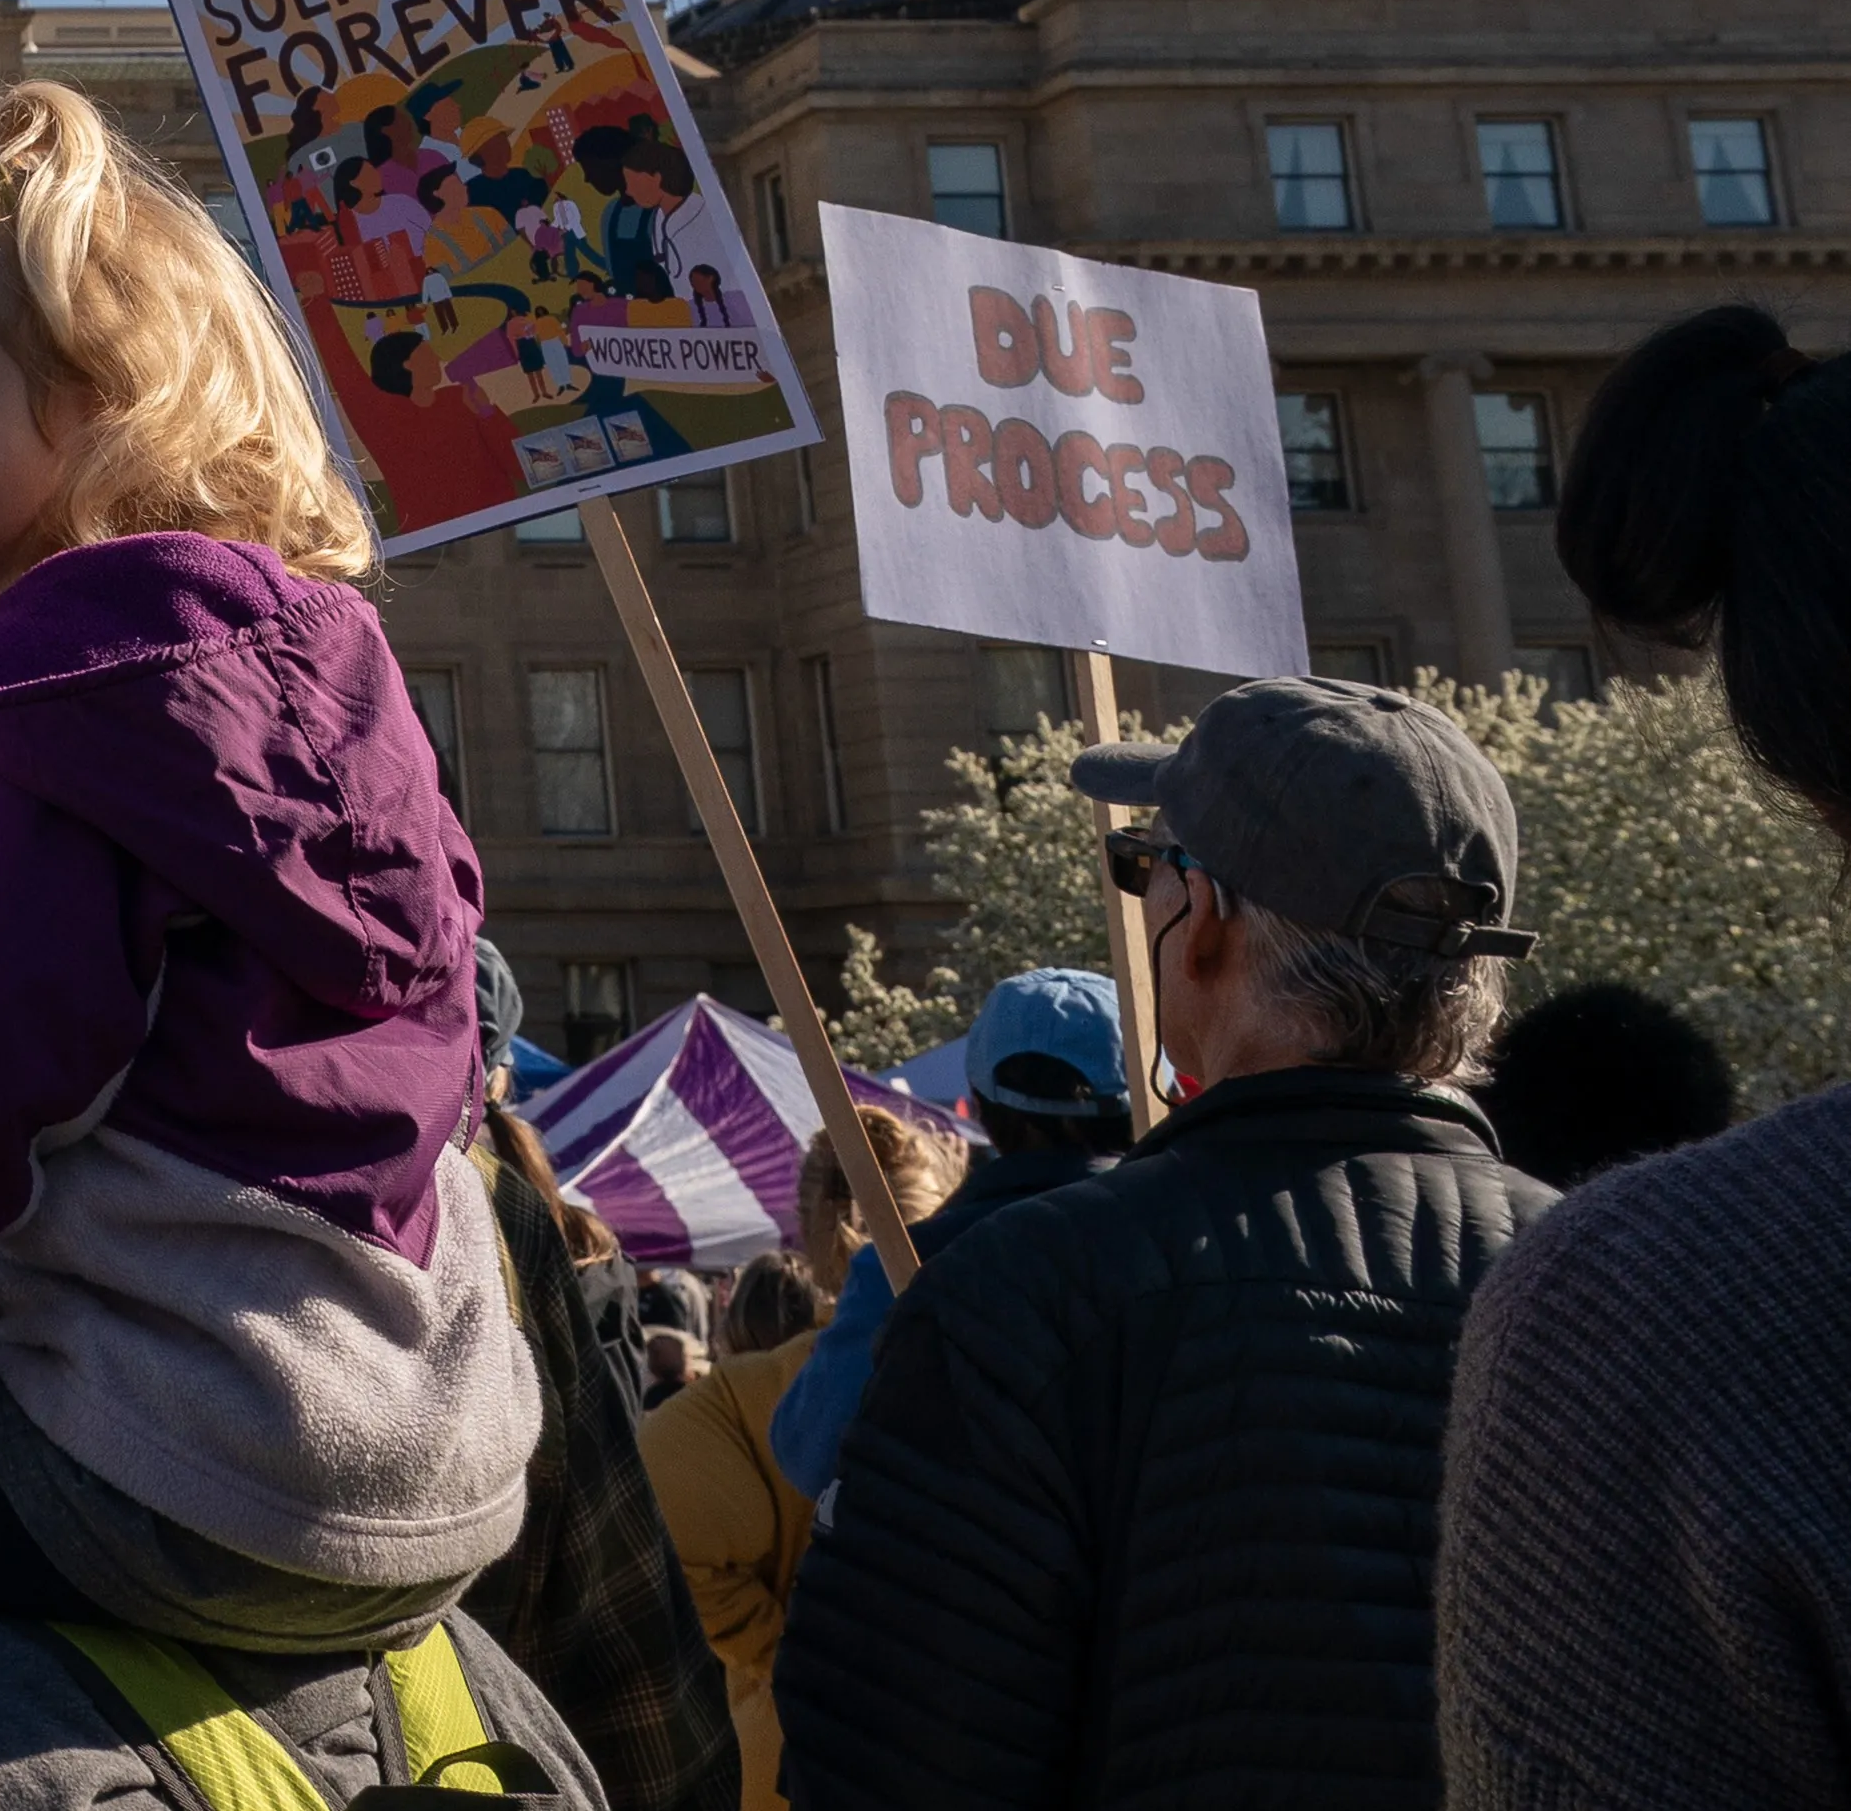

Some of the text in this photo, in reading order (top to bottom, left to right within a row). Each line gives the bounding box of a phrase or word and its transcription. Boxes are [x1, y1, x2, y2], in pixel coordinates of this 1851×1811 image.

[588, 336, 762, 371] WORKER POWER
[967, 284, 1145, 405] DUE
[884, 390, 1250, 562] PROCESS
